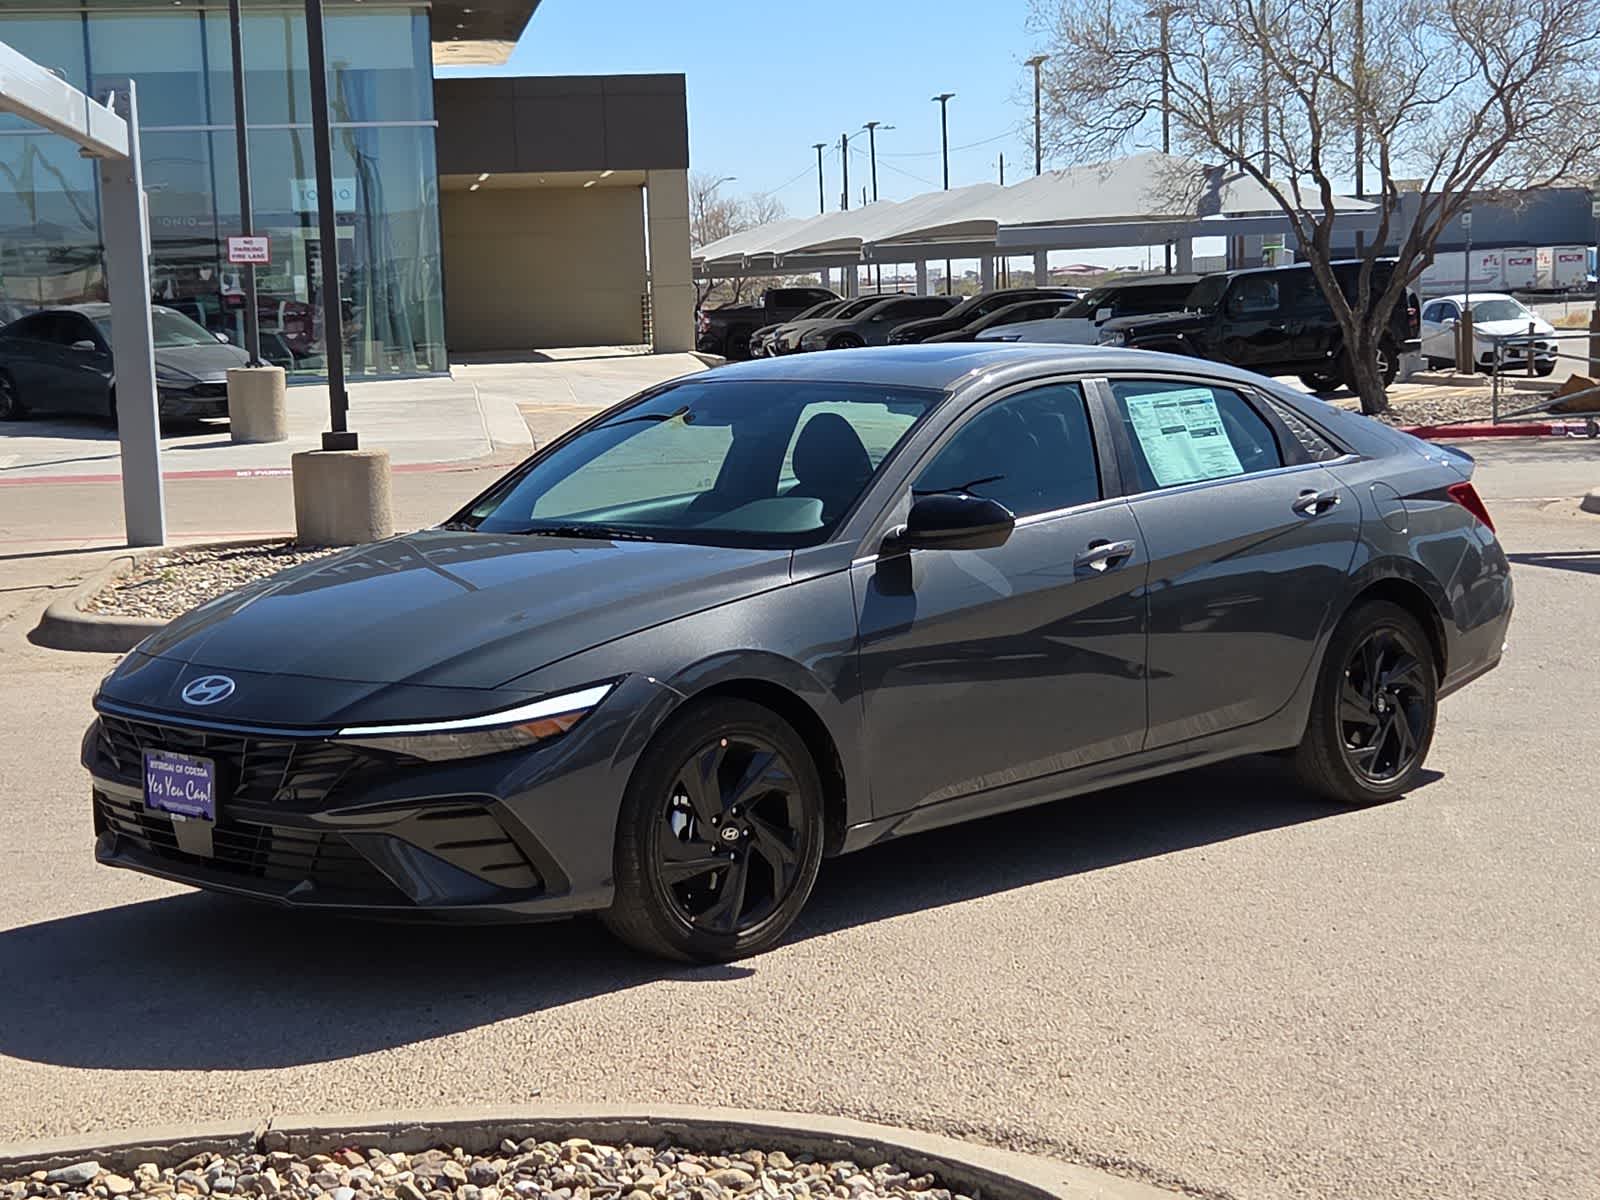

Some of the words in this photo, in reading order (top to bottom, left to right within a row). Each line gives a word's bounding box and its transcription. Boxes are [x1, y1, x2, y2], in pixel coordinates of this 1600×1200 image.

[175, 764, 183, 773] OF
[184, 766, 208, 777] ODESSA
[147, 773, 162, 795] Yes
[165, 776, 184, 797] You
[186, 780, 211, 802] Can!
